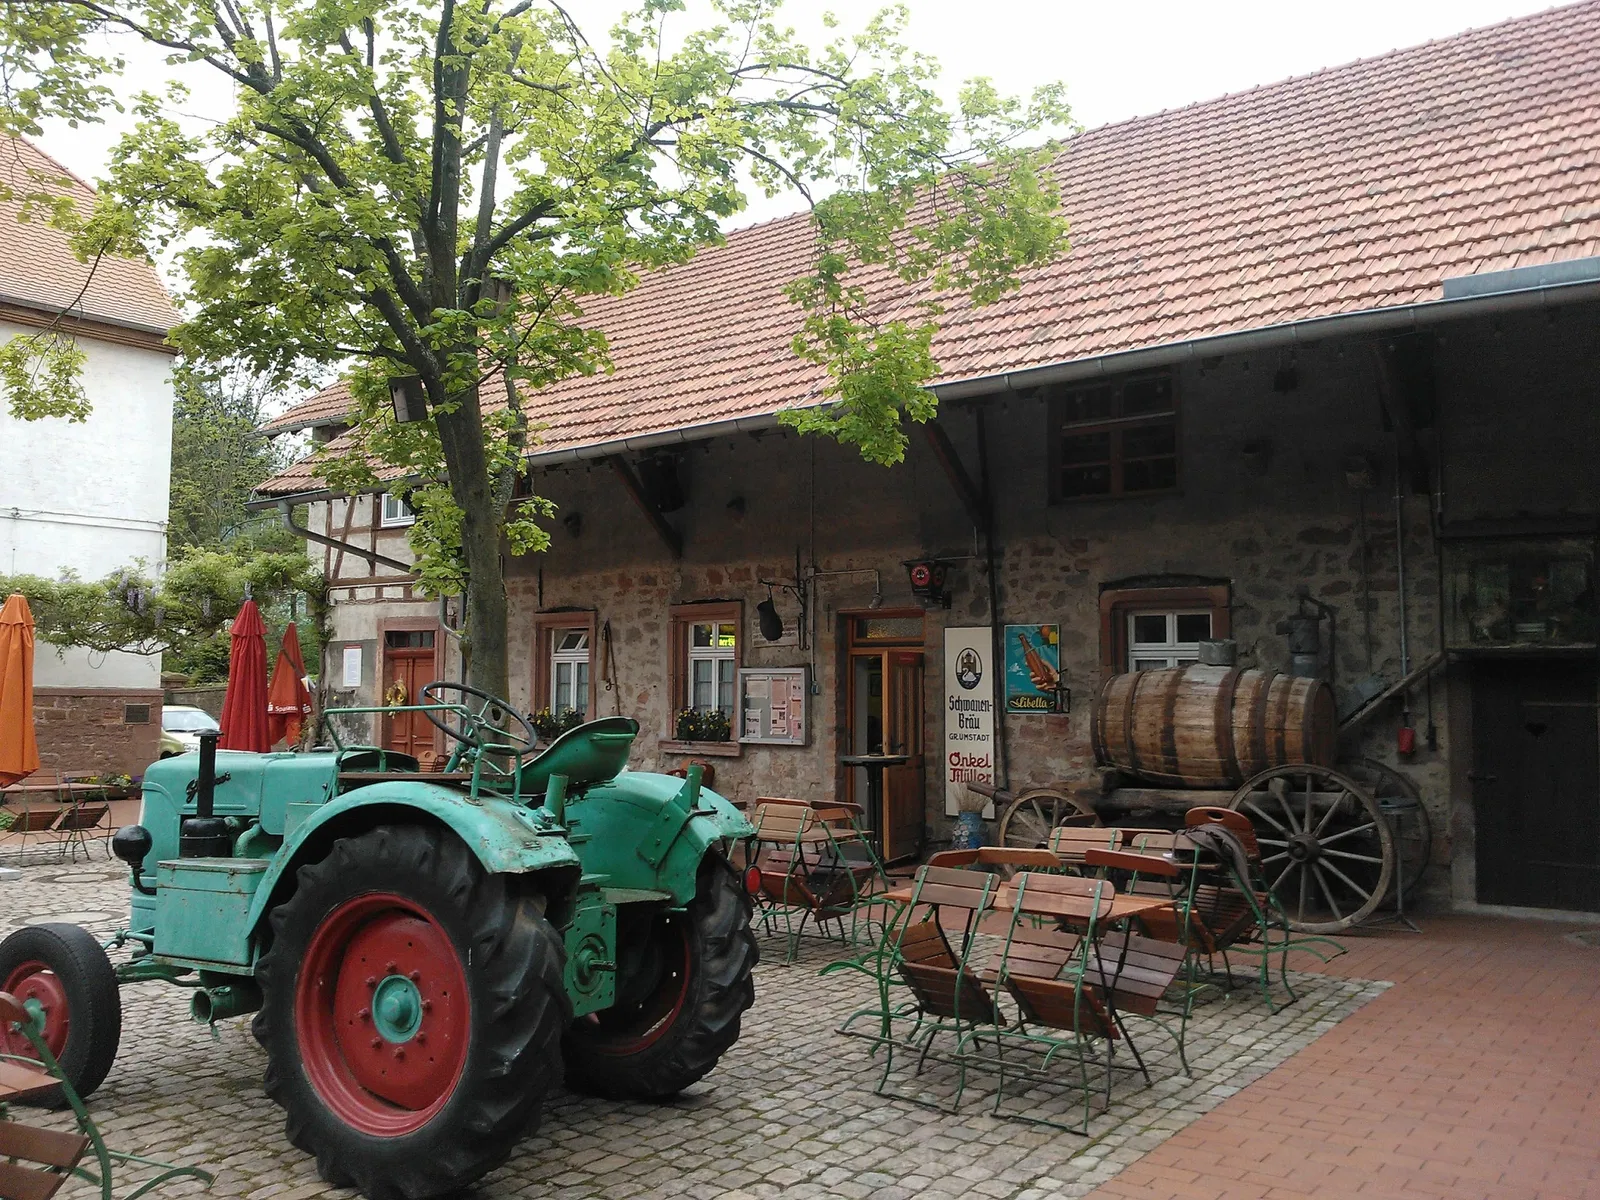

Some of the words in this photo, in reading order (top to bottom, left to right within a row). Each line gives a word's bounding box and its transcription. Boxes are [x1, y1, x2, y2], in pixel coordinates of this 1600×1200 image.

[949, 695, 993, 712] Schwanen-
[1013, 696, 1048, 709] Libella
[958, 712, 980, 729] Bräu
[949, 768, 992, 785] Müller
